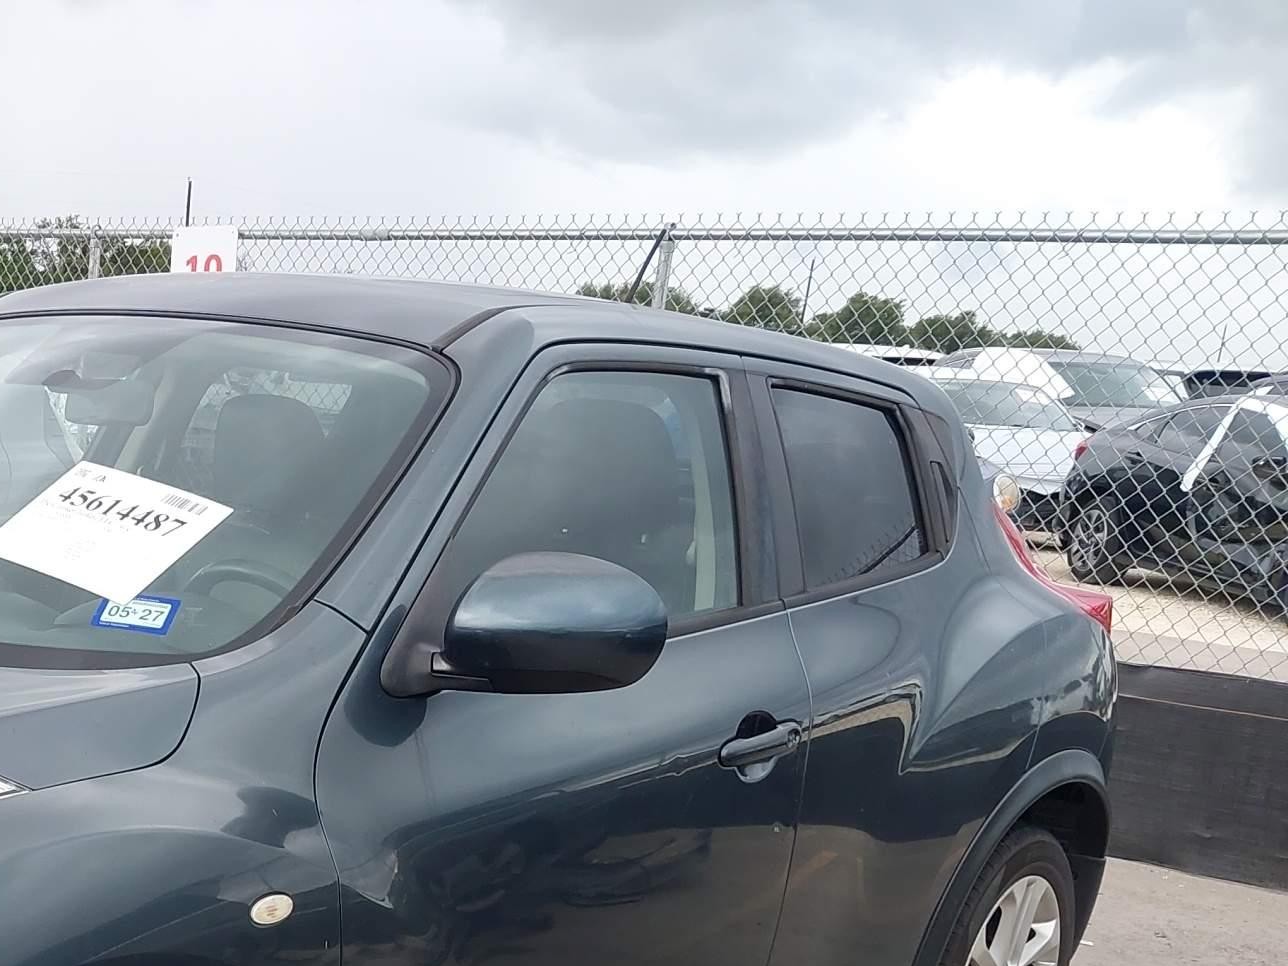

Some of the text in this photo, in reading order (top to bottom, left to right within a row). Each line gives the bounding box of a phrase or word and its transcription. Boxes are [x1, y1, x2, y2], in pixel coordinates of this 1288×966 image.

[186, 254, 223, 273] 10
[58, 486, 188, 537] 45614487
[107, 604, 166, 622] 05 27
